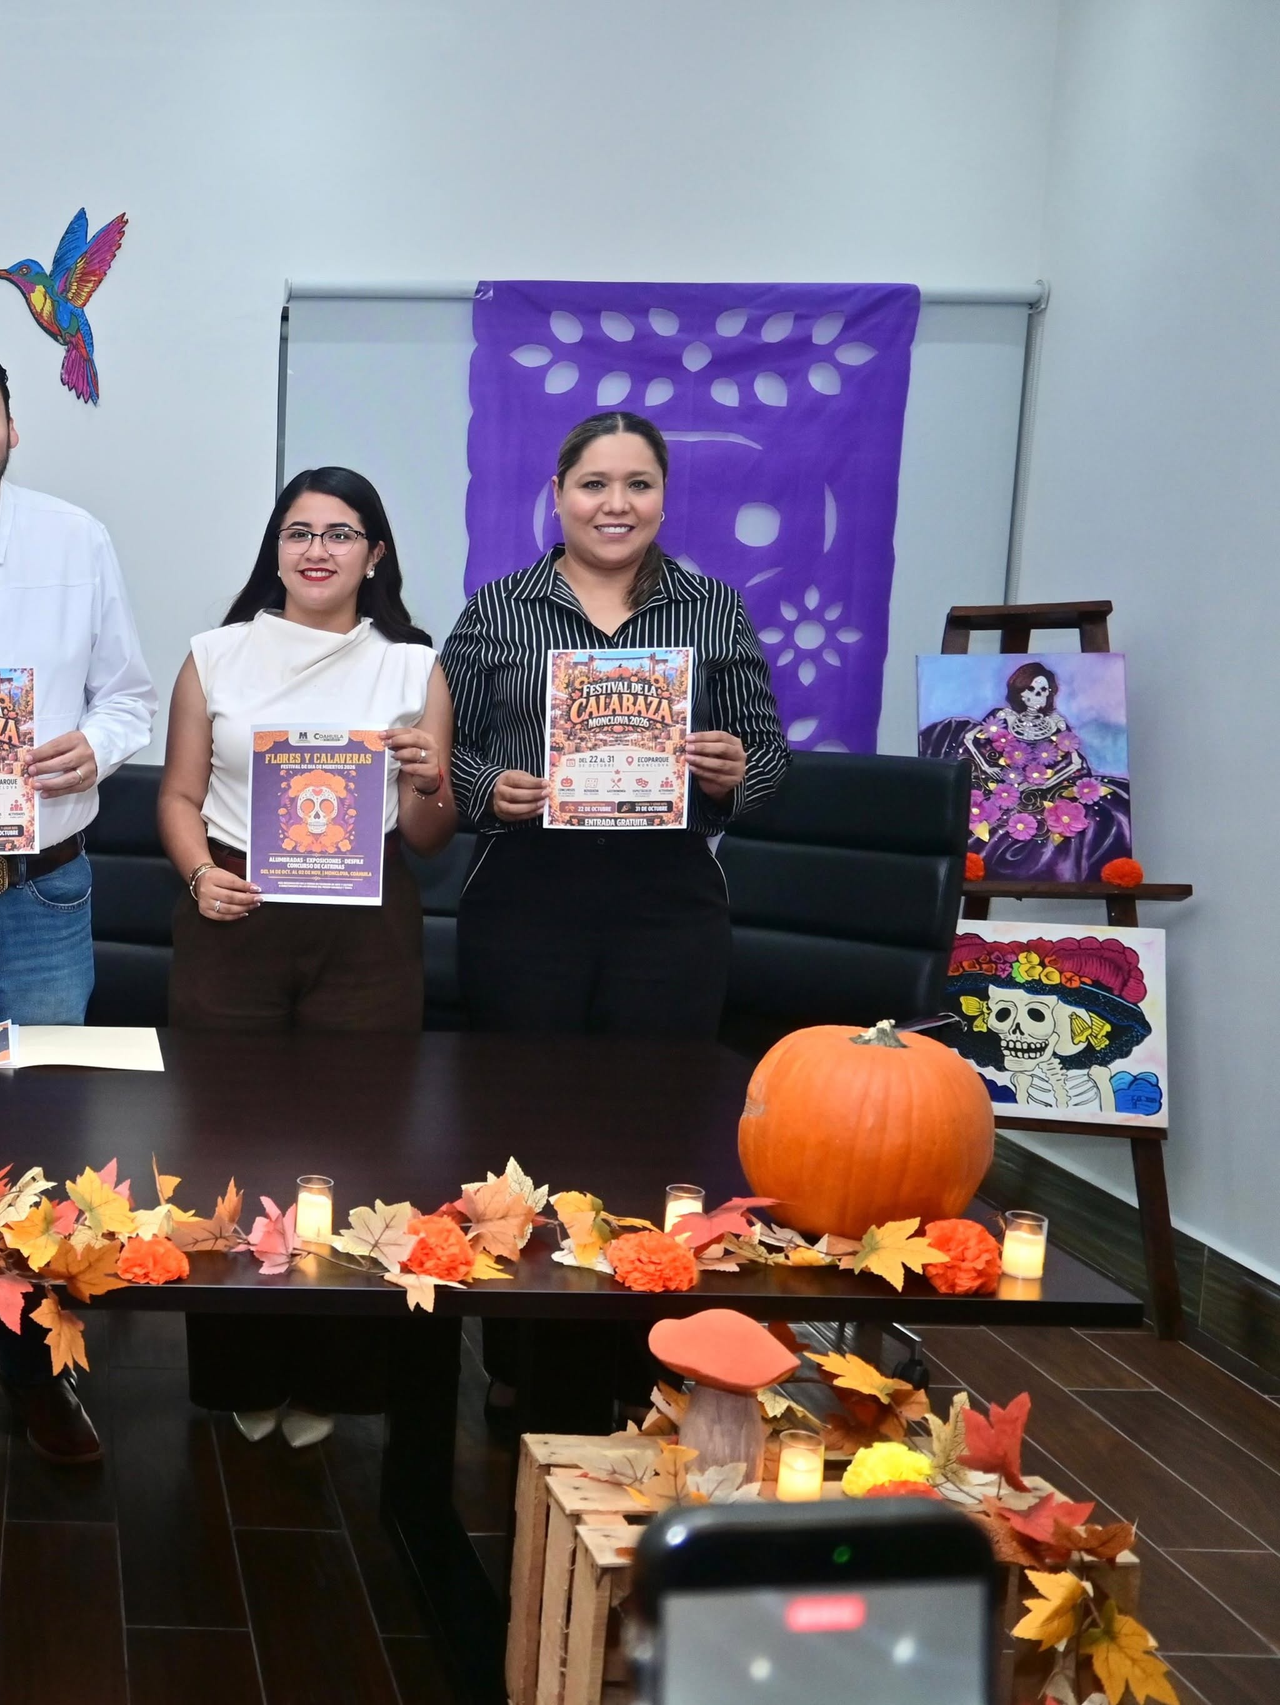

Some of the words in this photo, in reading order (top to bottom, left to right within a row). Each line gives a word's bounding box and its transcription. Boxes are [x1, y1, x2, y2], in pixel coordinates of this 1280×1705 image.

[583, 681, 630, 697] FESTIVAL
[631, 683, 643, 694] DE
[645, 684, 657, 696] LA
[570, 694, 672, 724] CALABAZA
[588, 716, 628, 728] MONCLOVA
[630, 716, 649, 727] 2026
[265, 753, 301, 764] FLORES
[304, 753, 311, 763] Y
[314, 753, 371, 764] CALAVERAS
